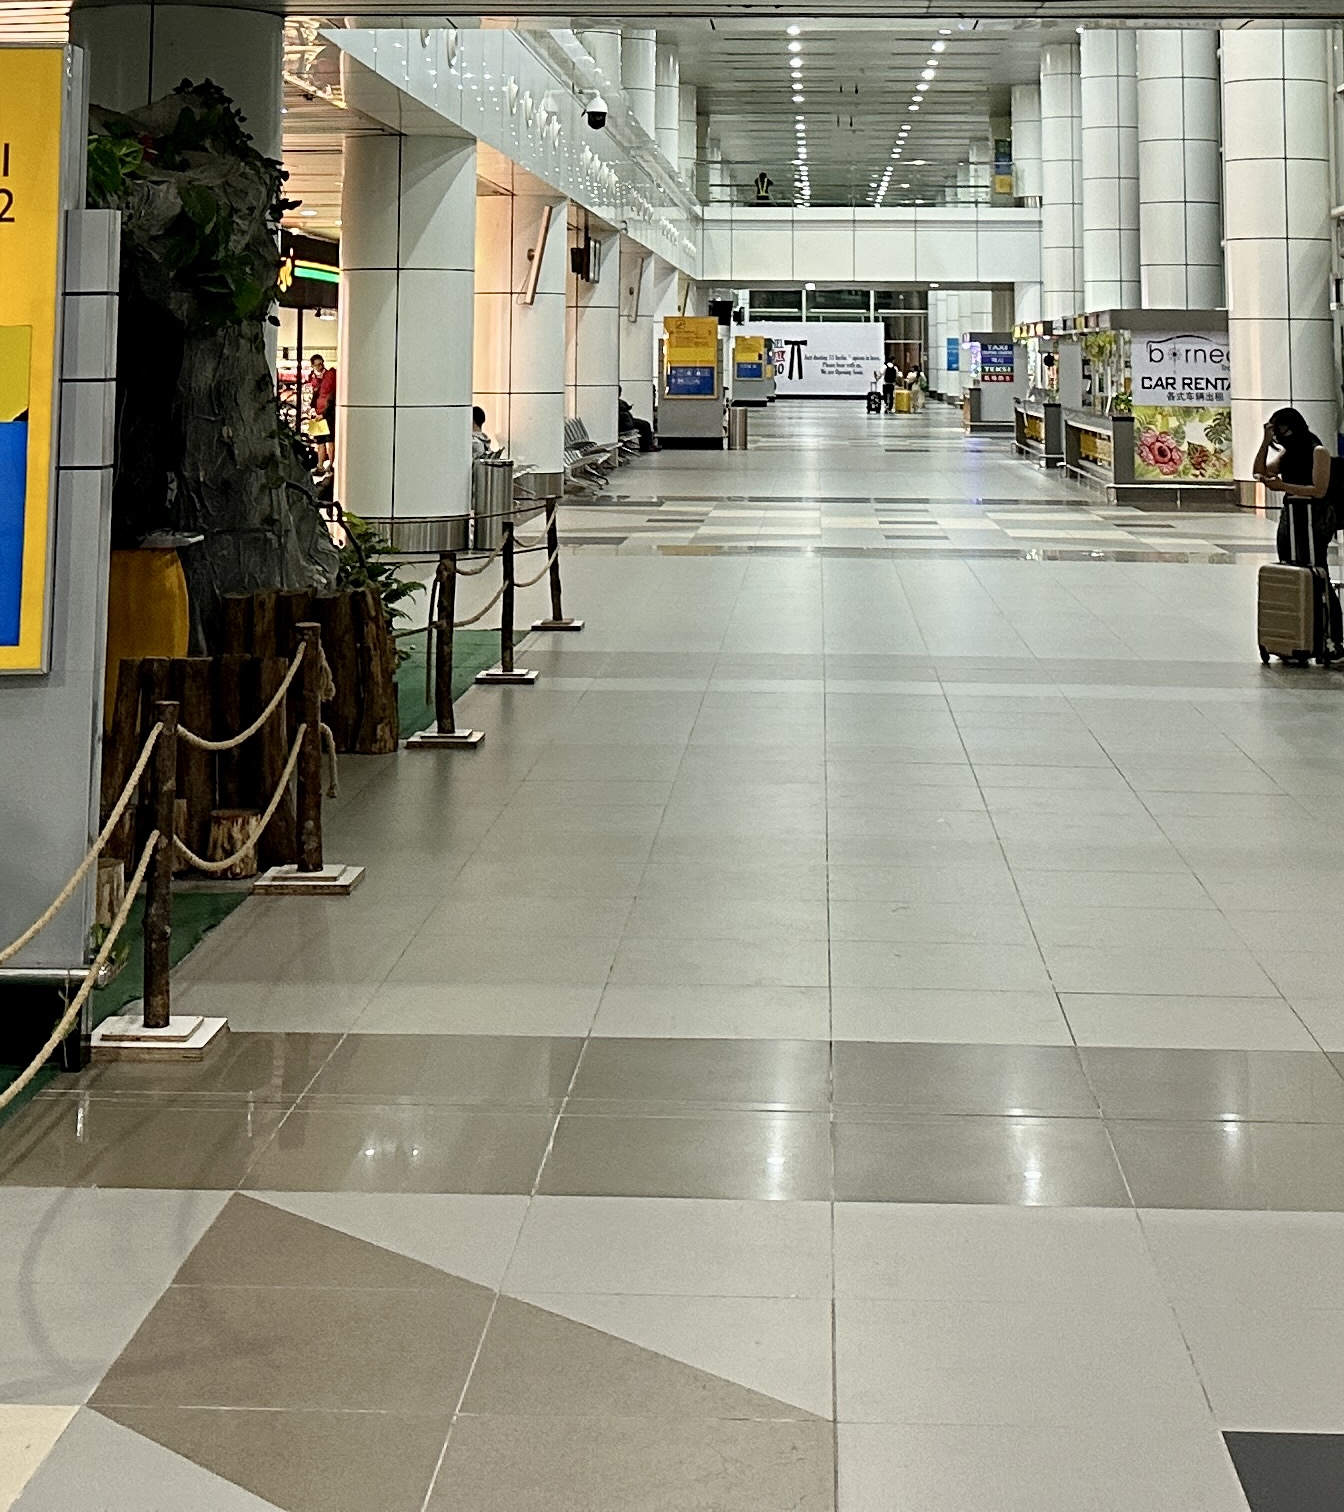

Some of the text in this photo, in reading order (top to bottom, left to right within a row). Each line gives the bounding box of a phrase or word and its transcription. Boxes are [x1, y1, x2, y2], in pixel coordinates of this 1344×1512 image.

[2, 142, 11, 178] 1
[1149, 344, 1231, 364] borne
[1141, 376, 1177, 390] CAR
